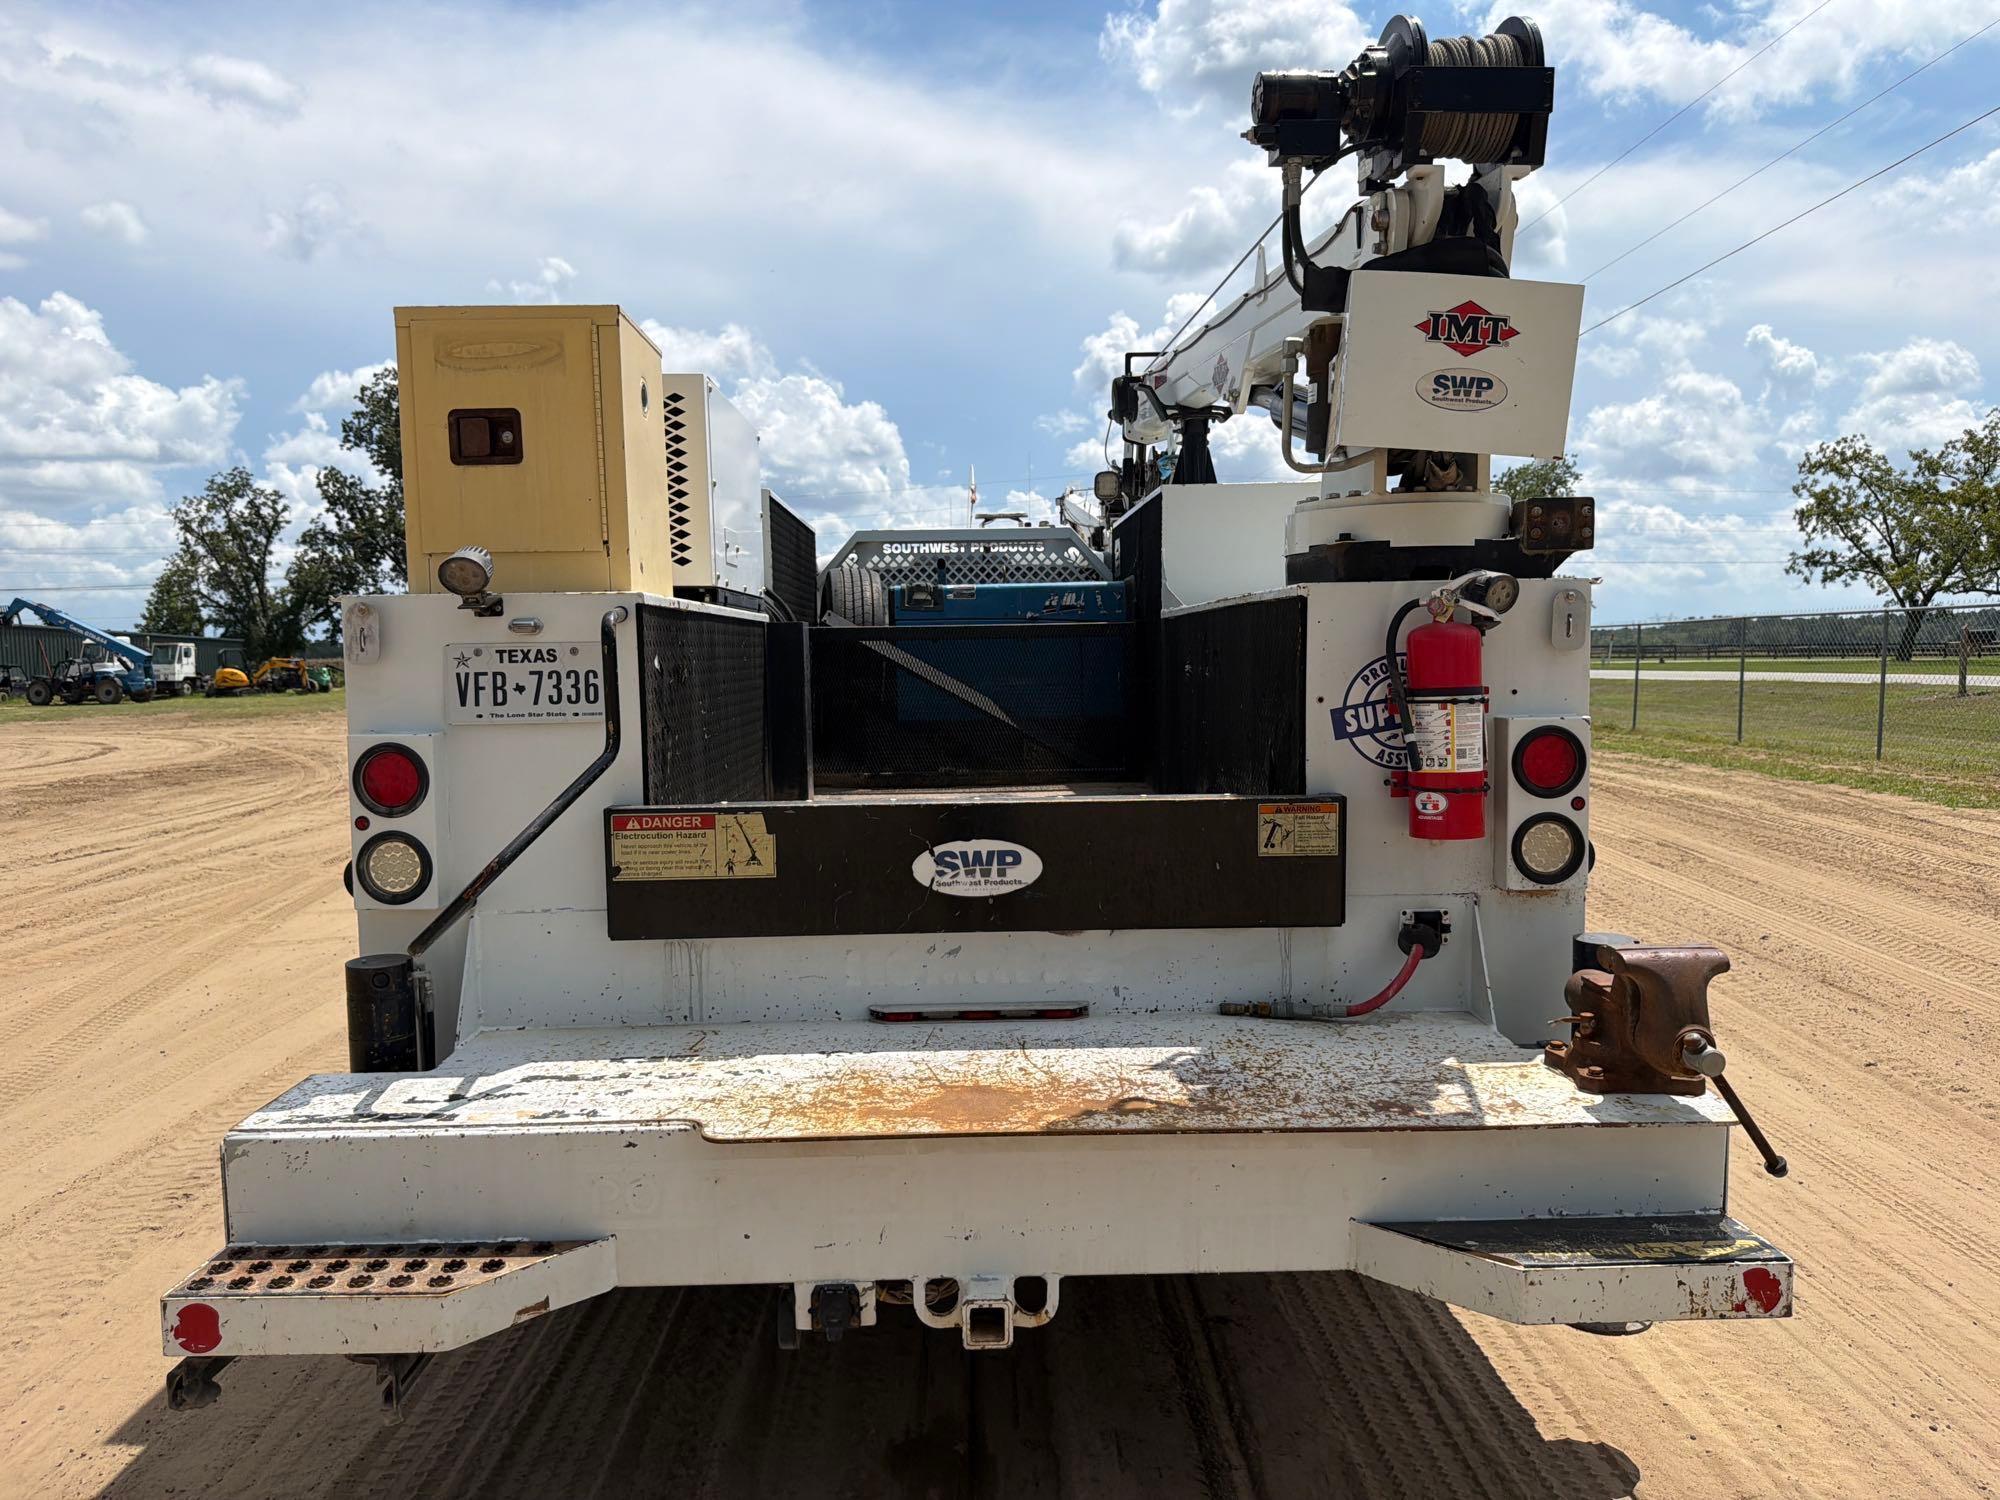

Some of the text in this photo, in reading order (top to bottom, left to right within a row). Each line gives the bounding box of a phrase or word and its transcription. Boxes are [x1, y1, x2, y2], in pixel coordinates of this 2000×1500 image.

[1427, 312, 1509, 346] IMT
[1432, 374, 1494, 398] SWP
[882, 543, 966, 554] SOUTHWEST
[495, 648, 558, 664] TEXAS
[455, 669, 600, 707] VFB 7336
[1283, 805, 1321, 813] WARNING
[643, 816, 702, 828] DANGER
[615, 831, 707, 841] Electrocution Hazard
[935, 849, 1022, 878] SWP
[984, 878, 1023, 886] Products
